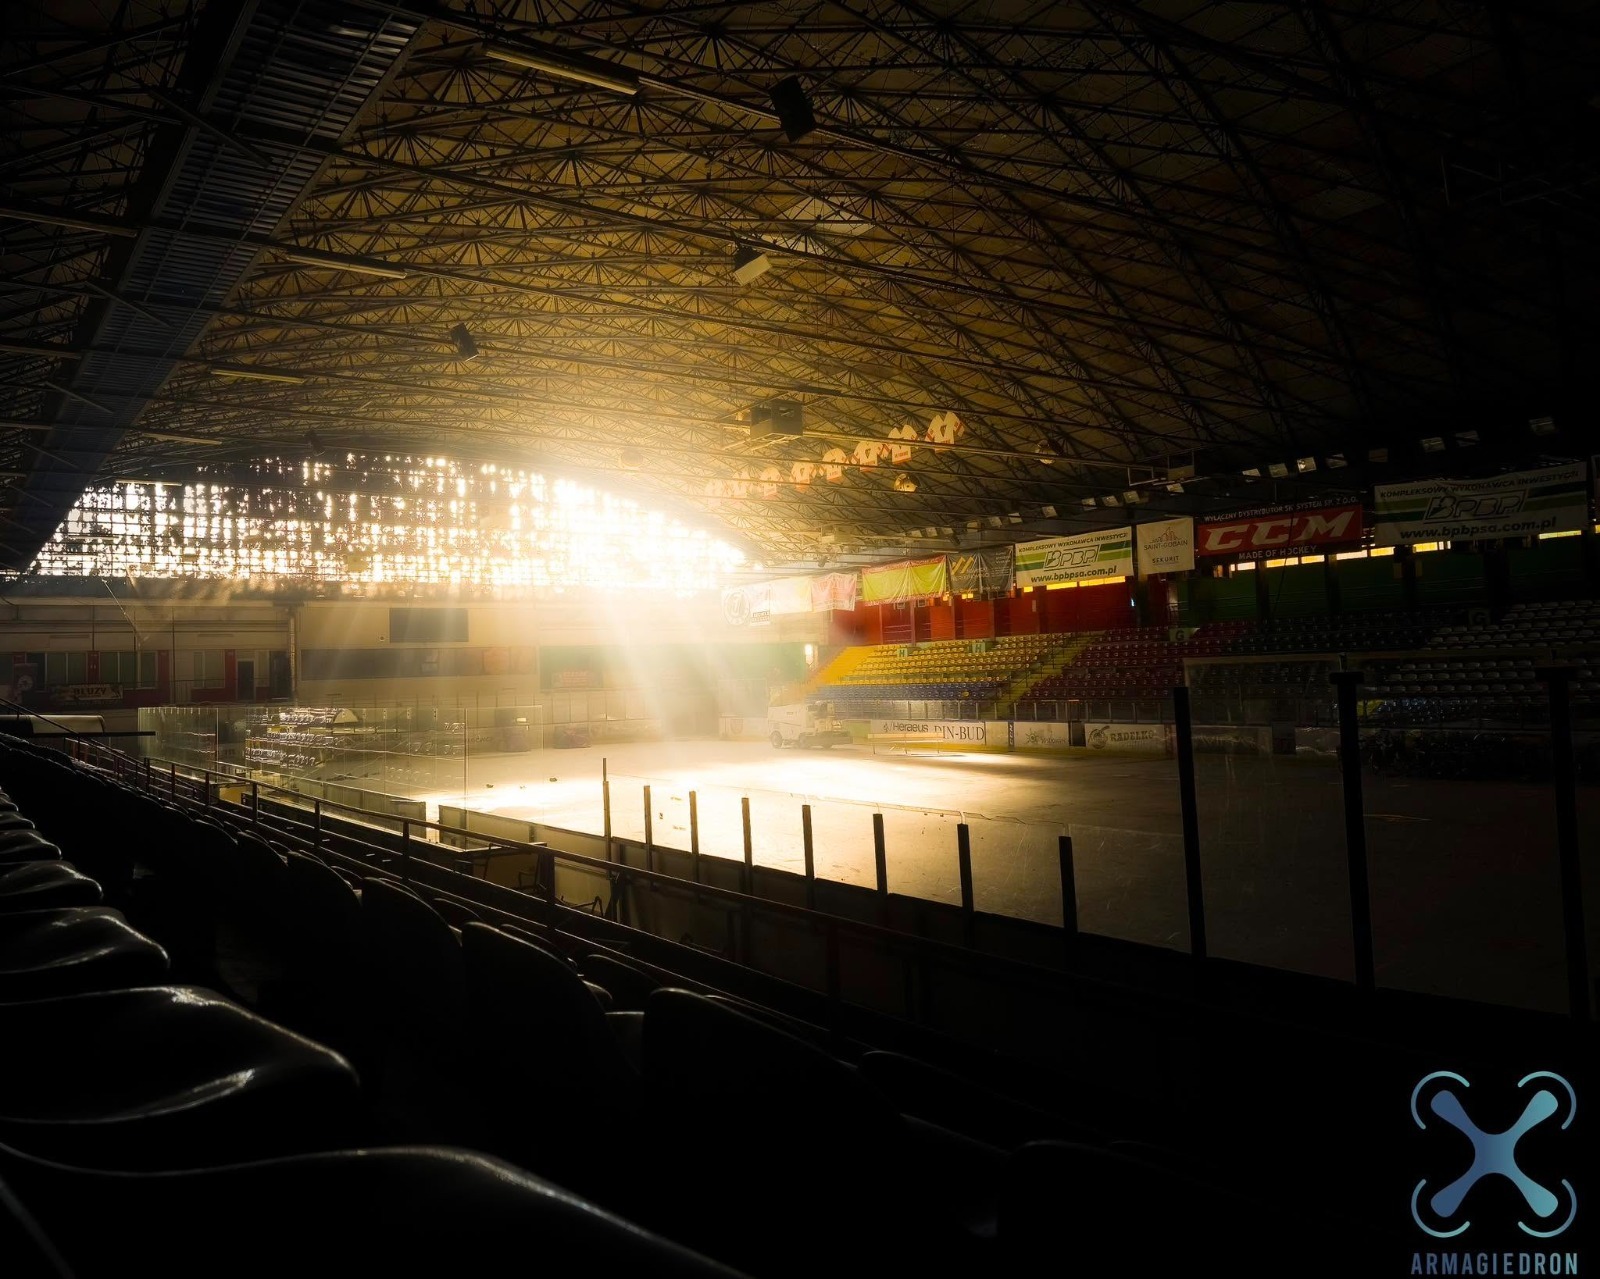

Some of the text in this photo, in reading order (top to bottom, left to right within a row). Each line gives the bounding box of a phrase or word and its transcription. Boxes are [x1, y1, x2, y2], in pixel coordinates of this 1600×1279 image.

[1380, 486, 1448, 498] KOMPLEKSOWY
[1450, 480, 1515, 492] WYKONAWCA
[1427, 496, 1521, 520] BPBP
[1204, 511, 1356, 551] CCM
[1400, 516, 1556, 539] www.bpbpsa.com.pl
[1019, 543, 1057, 553] KOMPLEKSOWY
[1058, 537, 1094, 547] WYKONAWCA
[1144, 540, 1188, 551] SAINT-GOBAIN
[1239, 545, 1317, 560] MADE OF HOCKEY
[1046, 549, 1097, 569] BPBP
[1031, 565, 1117, 583] www.bpbpsa.com.pl
[893, 722, 929, 733] Heraeus
